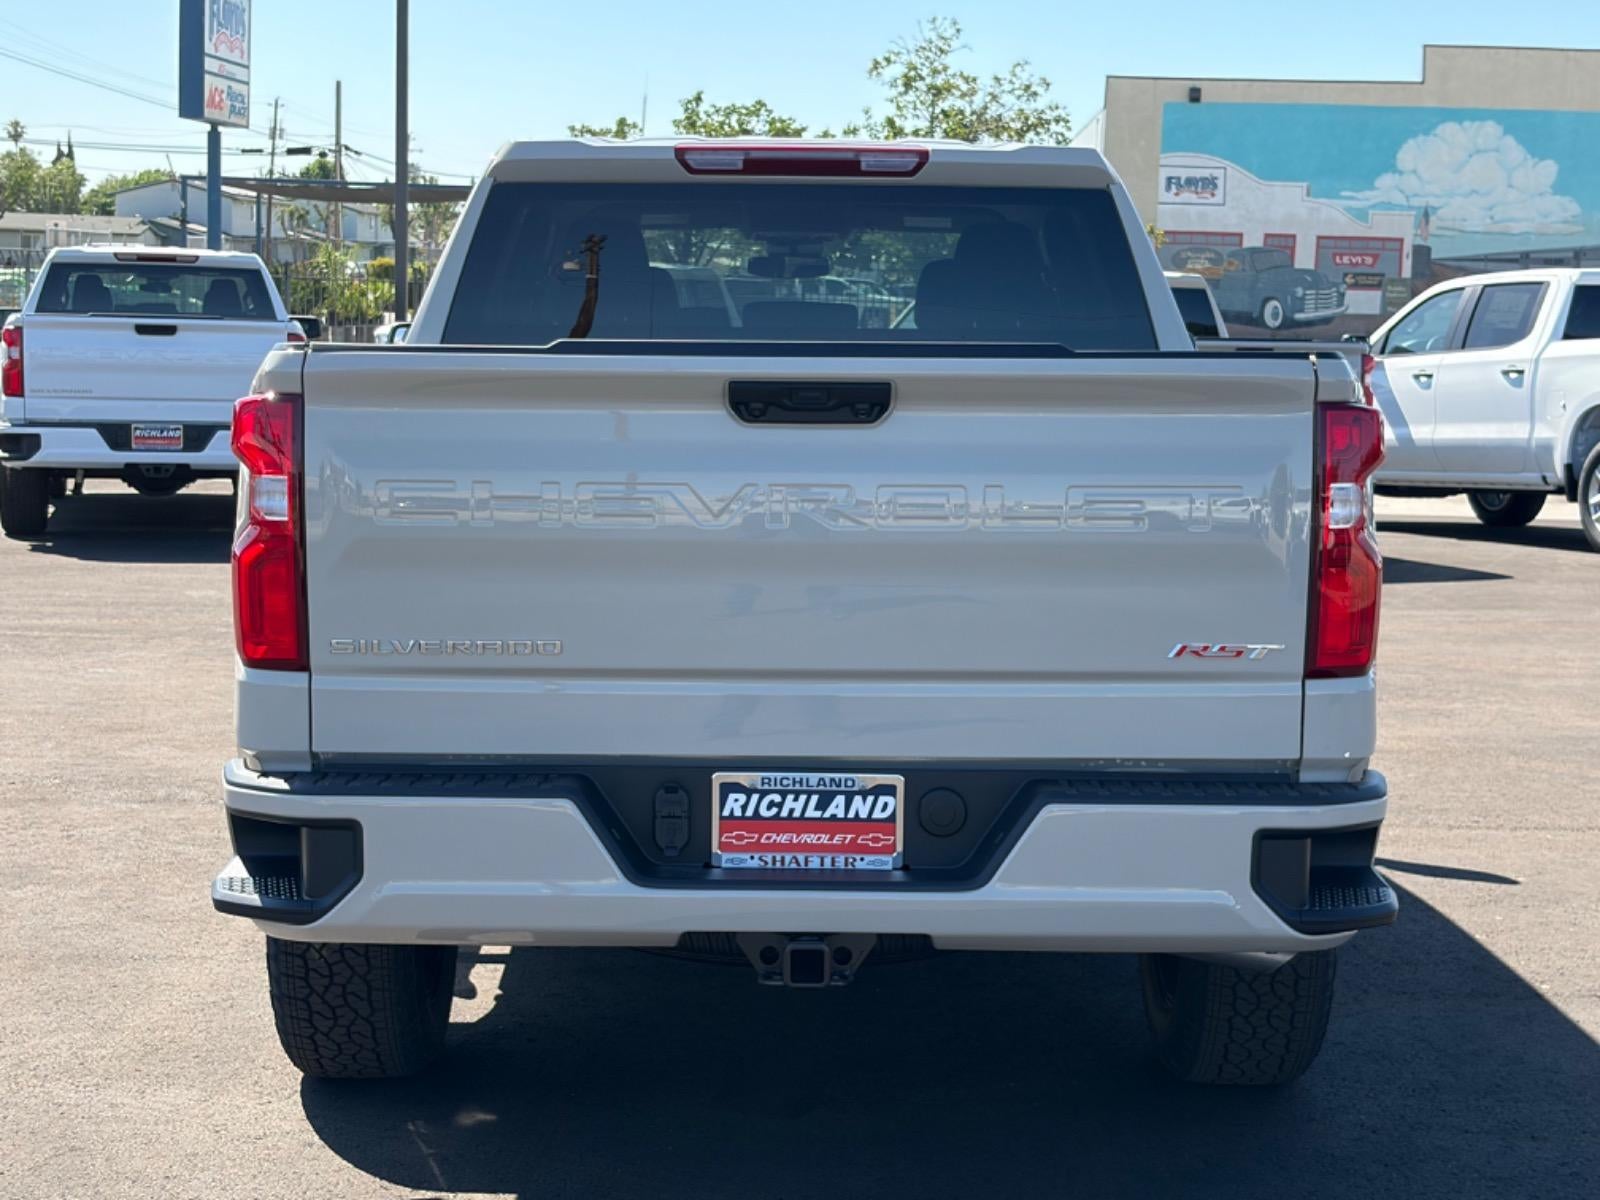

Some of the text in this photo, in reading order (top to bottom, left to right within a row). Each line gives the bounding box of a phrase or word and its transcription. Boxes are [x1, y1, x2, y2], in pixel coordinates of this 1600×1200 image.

[134, 429, 182, 438] RICHLAND
[374, 479, 1244, 533] CHEVROLET
[329, 638, 564, 657] SILVERADO
[1167, 642, 1286, 660] RST
[760, 776, 857, 789] RICHLAND
[721, 792, 897, 820] RICHLAND
[759, 832, 858, 845] CHEVROLET
[756, 854, 858, 869] SHAFTER
